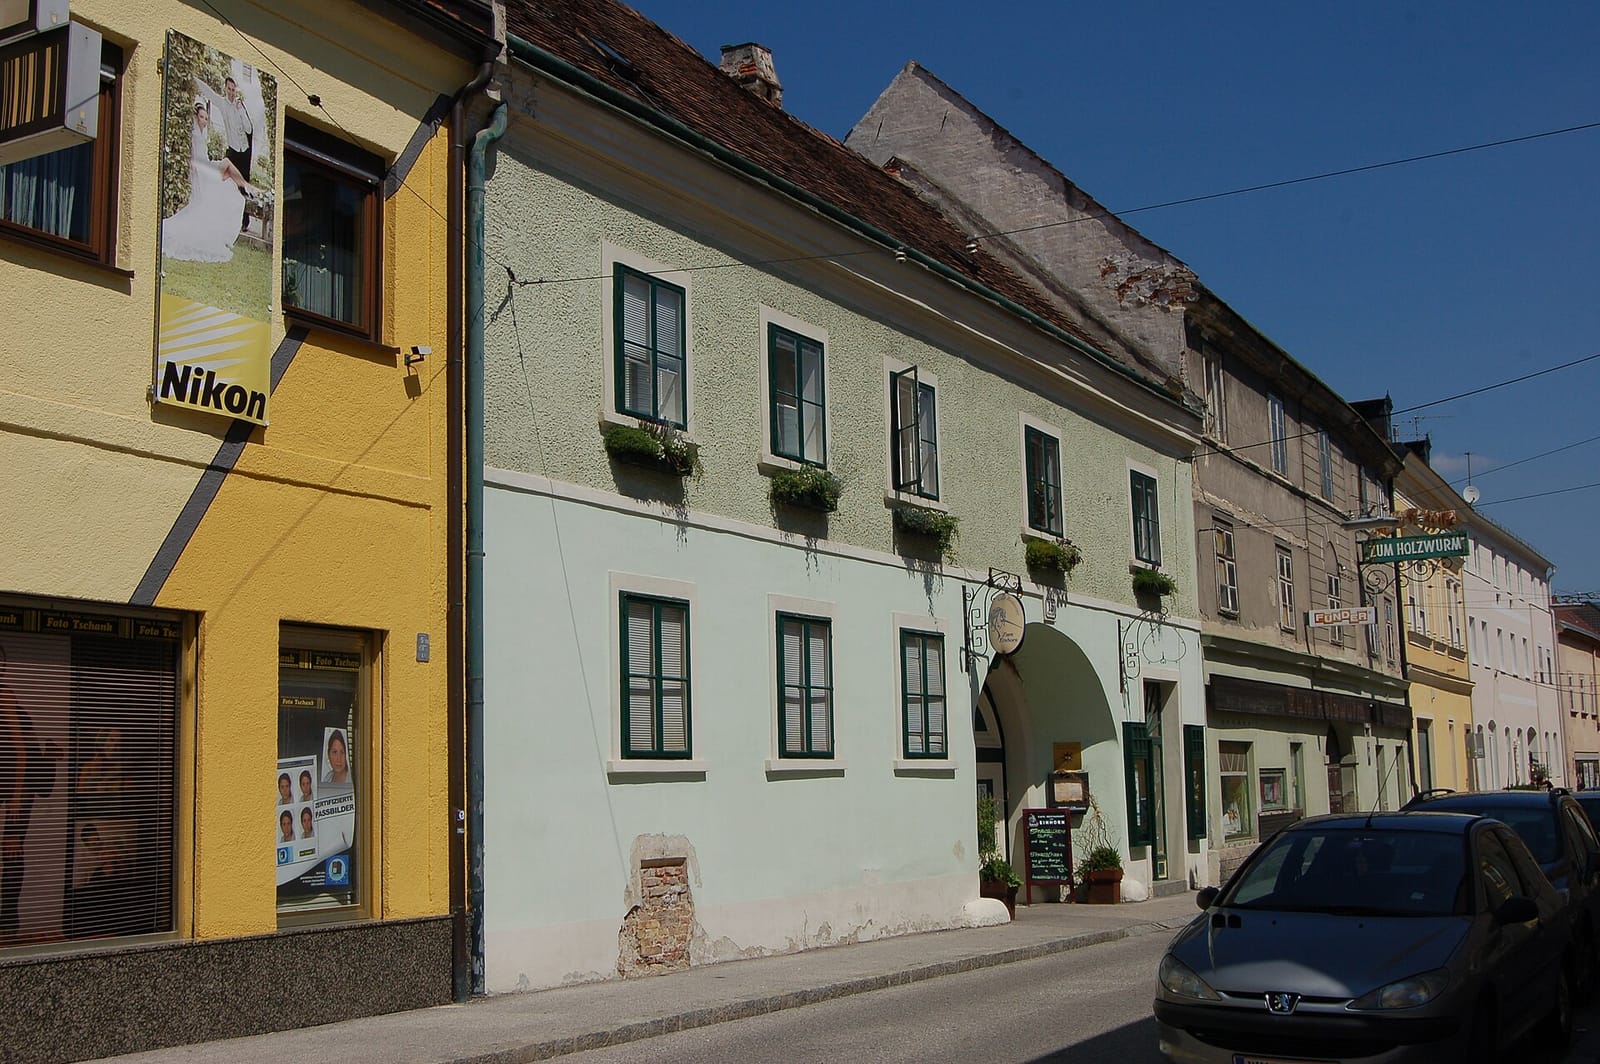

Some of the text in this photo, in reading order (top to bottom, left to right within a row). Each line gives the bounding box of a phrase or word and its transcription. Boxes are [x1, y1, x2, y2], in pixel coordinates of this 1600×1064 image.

[160, 360, 267, 421] Nikon
[1315, 610, 1368, 624] FUNDER
[46, 617, 113, 633] Foto Tschank
[139, 625, 160, 636] Foto
[315, 795, 353, 808] ZERTIFIZIERTE
[315, 804, 355, 819] PASSBILDER
